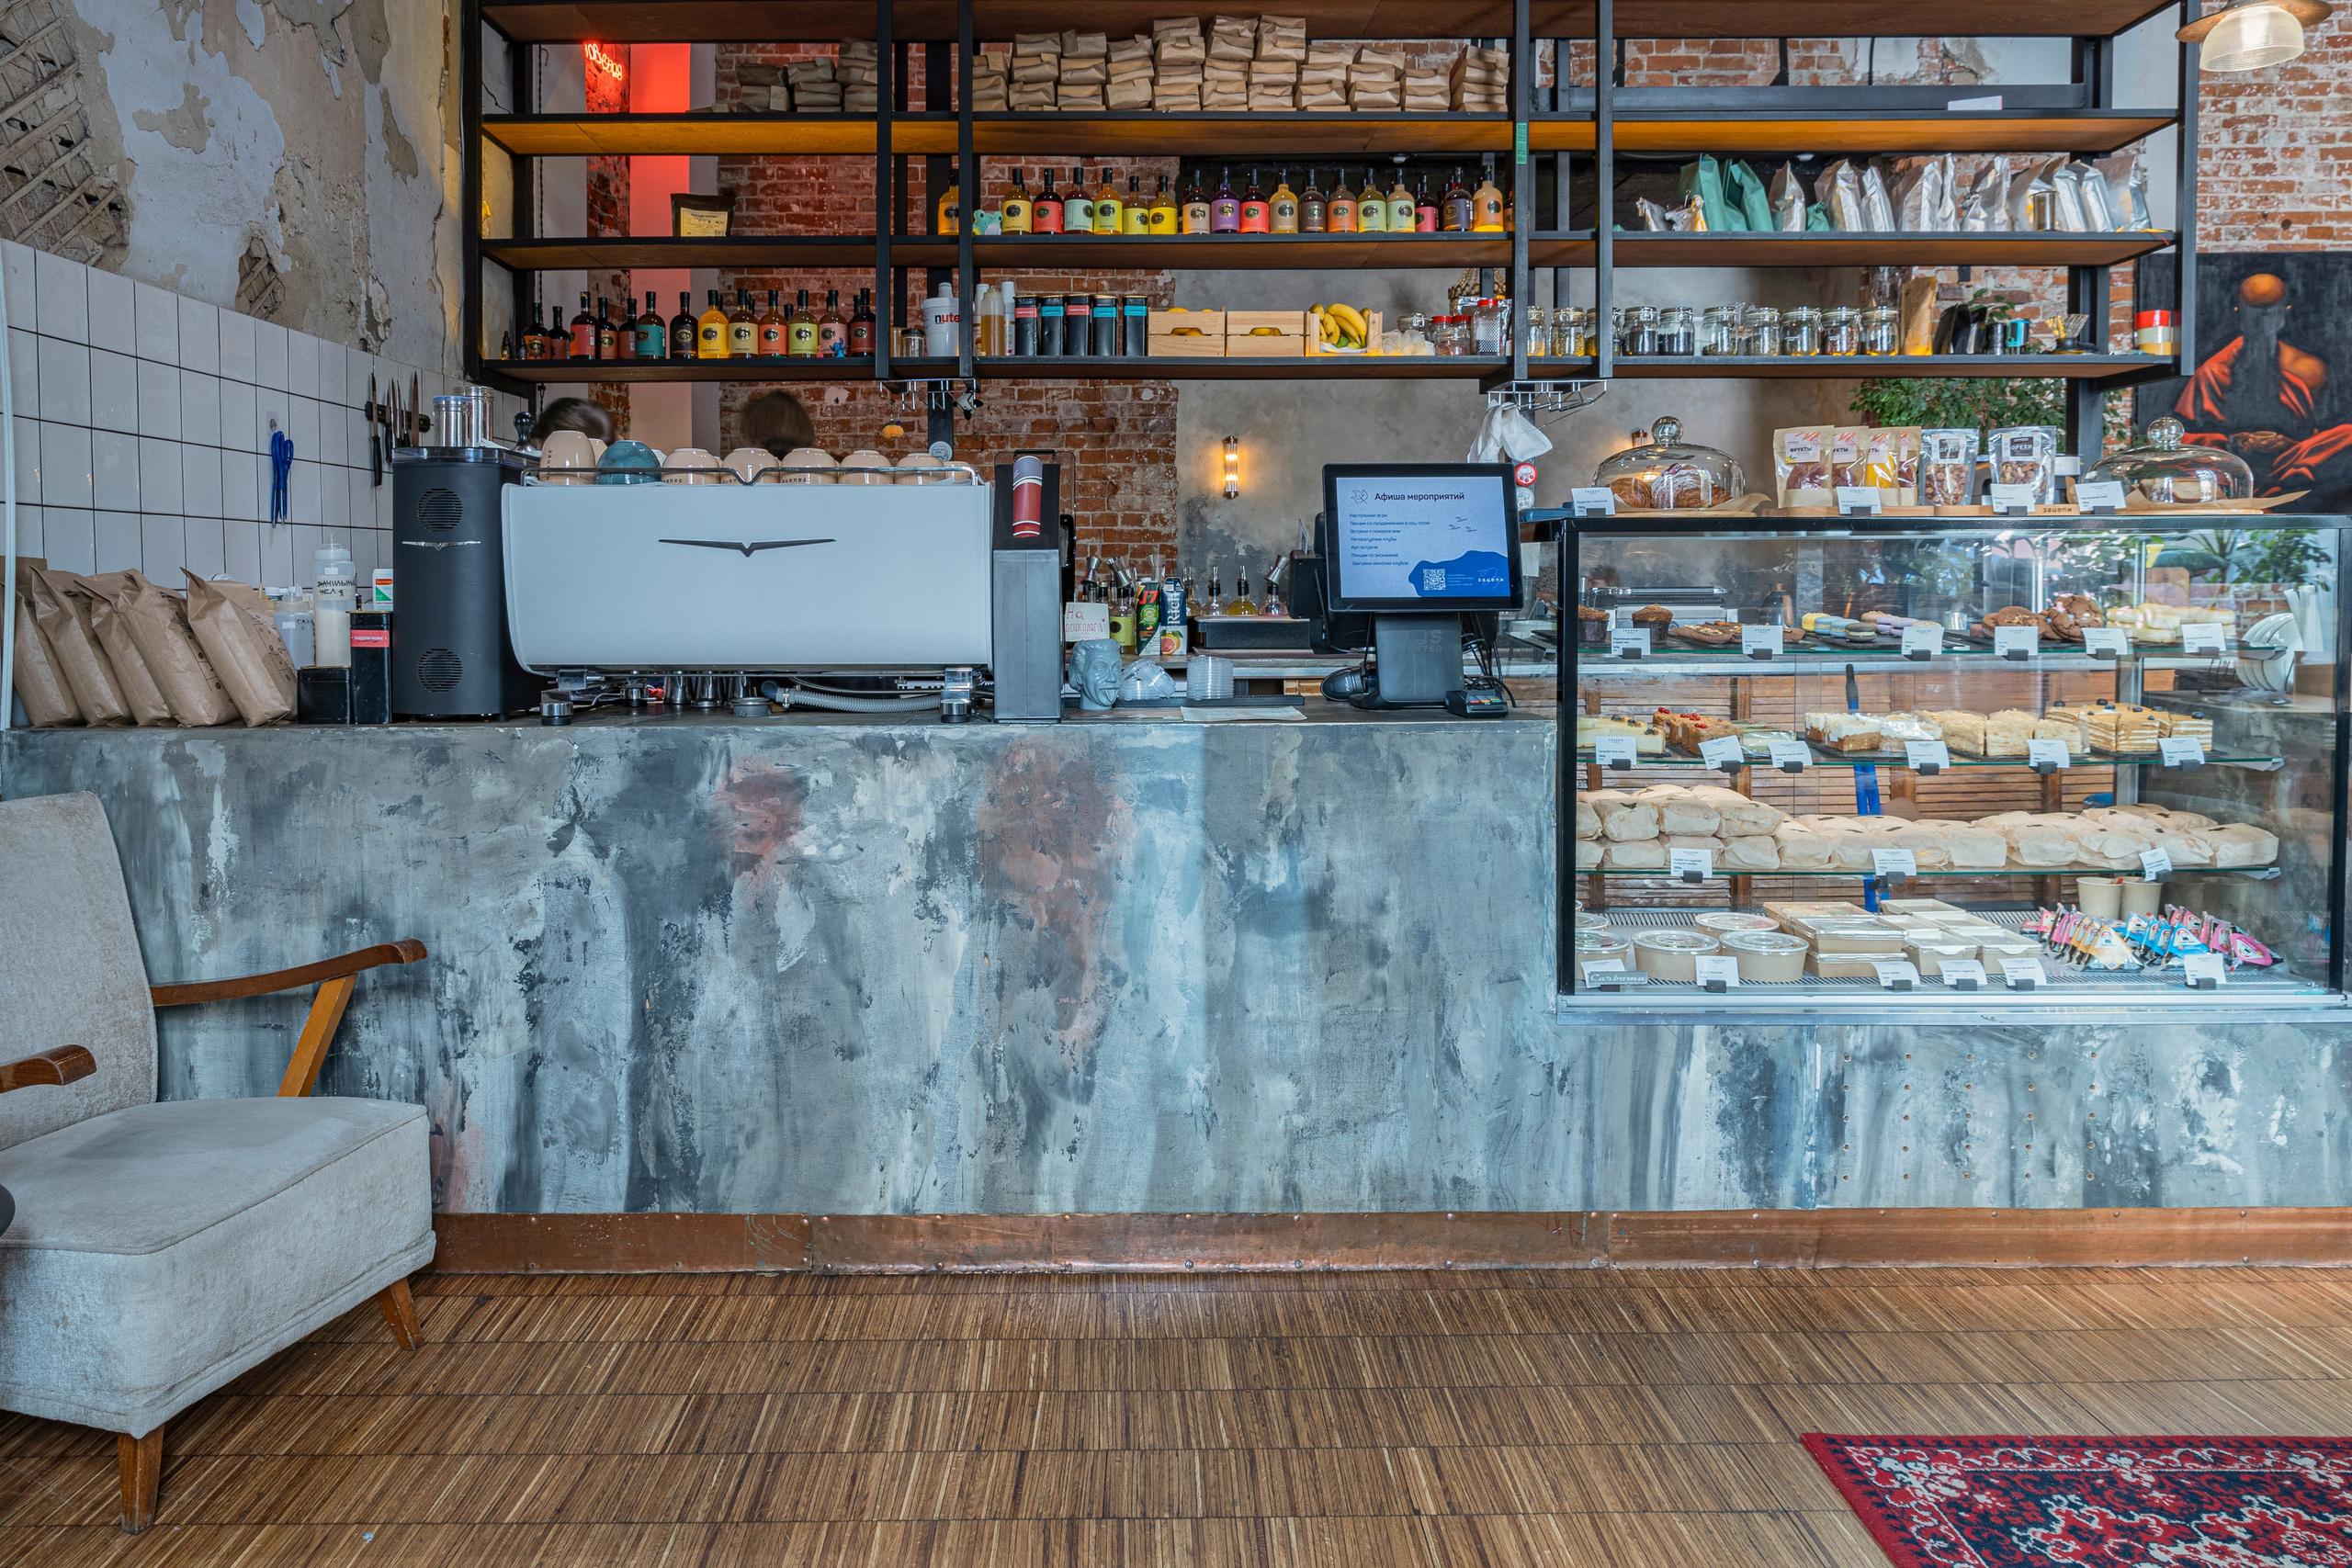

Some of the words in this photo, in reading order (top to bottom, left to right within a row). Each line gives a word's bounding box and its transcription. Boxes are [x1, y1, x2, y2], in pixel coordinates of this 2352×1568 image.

[1374, 492, 1406, 502] Афиша
[1407, 491, 1464, 502] мероприятий
[1139, 590, 1159, 605] J7
[1066, 604, 1084, 620] На
[1167, 591, 1181, 626] Rich
[1065, 622, 1103, 633] психолога
[1589, 974, 1645, 982] Carboma
